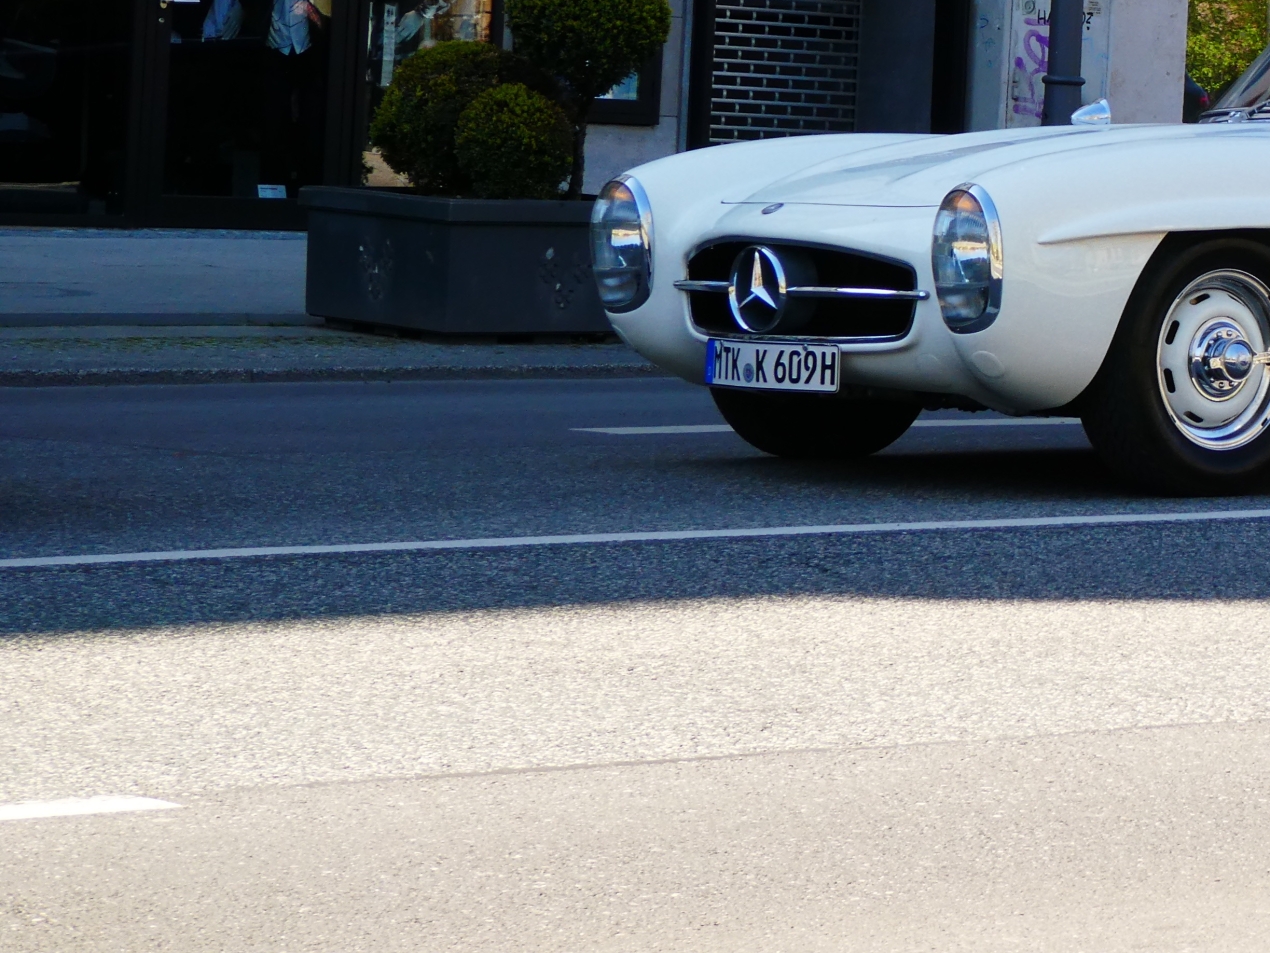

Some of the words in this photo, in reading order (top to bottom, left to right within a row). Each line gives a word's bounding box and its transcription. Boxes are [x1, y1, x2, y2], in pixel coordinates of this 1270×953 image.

[714, 346, 740, 381] MTK
[755, 349, 768, 383] K
[774, 350, 836, 386] 609H
